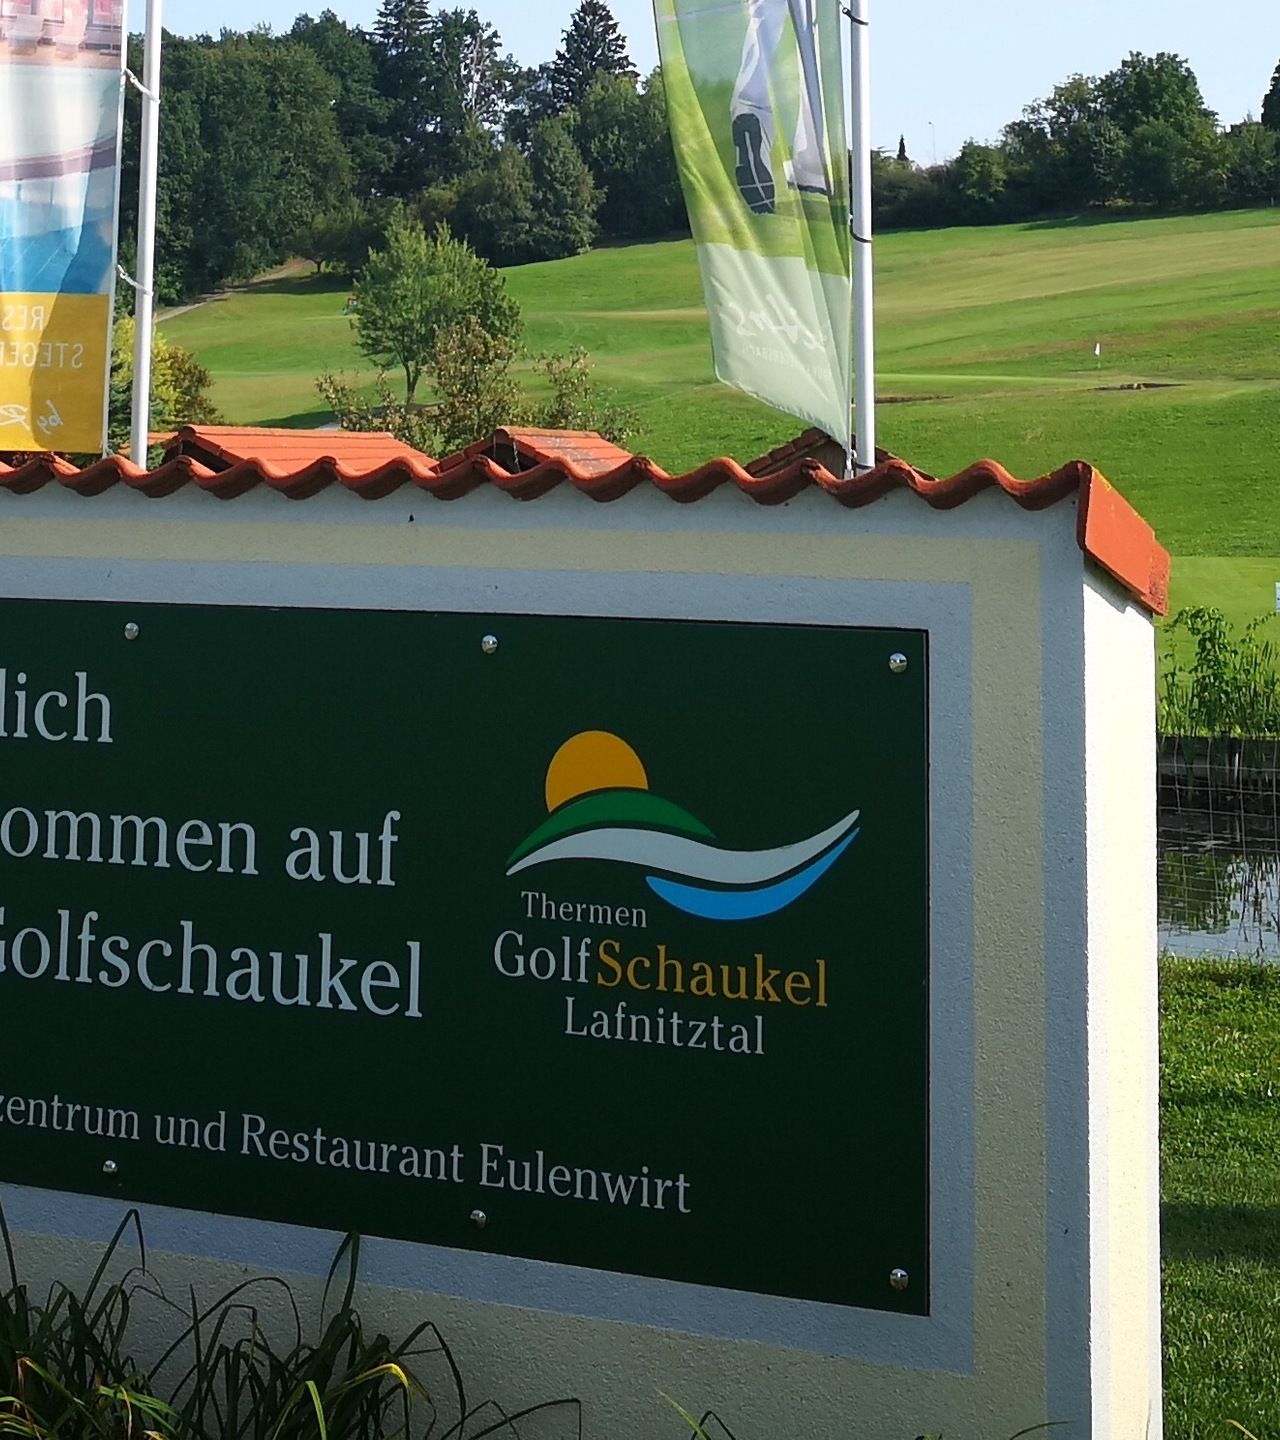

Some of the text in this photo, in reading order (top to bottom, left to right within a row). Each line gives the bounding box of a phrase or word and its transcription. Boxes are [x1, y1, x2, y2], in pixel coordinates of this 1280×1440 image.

[284, 809, 402, 887] auf
[521, 890, 648, 929] Thermen
[493, 930, 828, 1008] GolfSchaukel
[564, 996, 766, 1056] Lafnitztal
[153, 1109, 227, 1152] und
[239, 1112, 465, 1184] Restaurant
[479, 1143, 691, 1213] Eulenwirt
